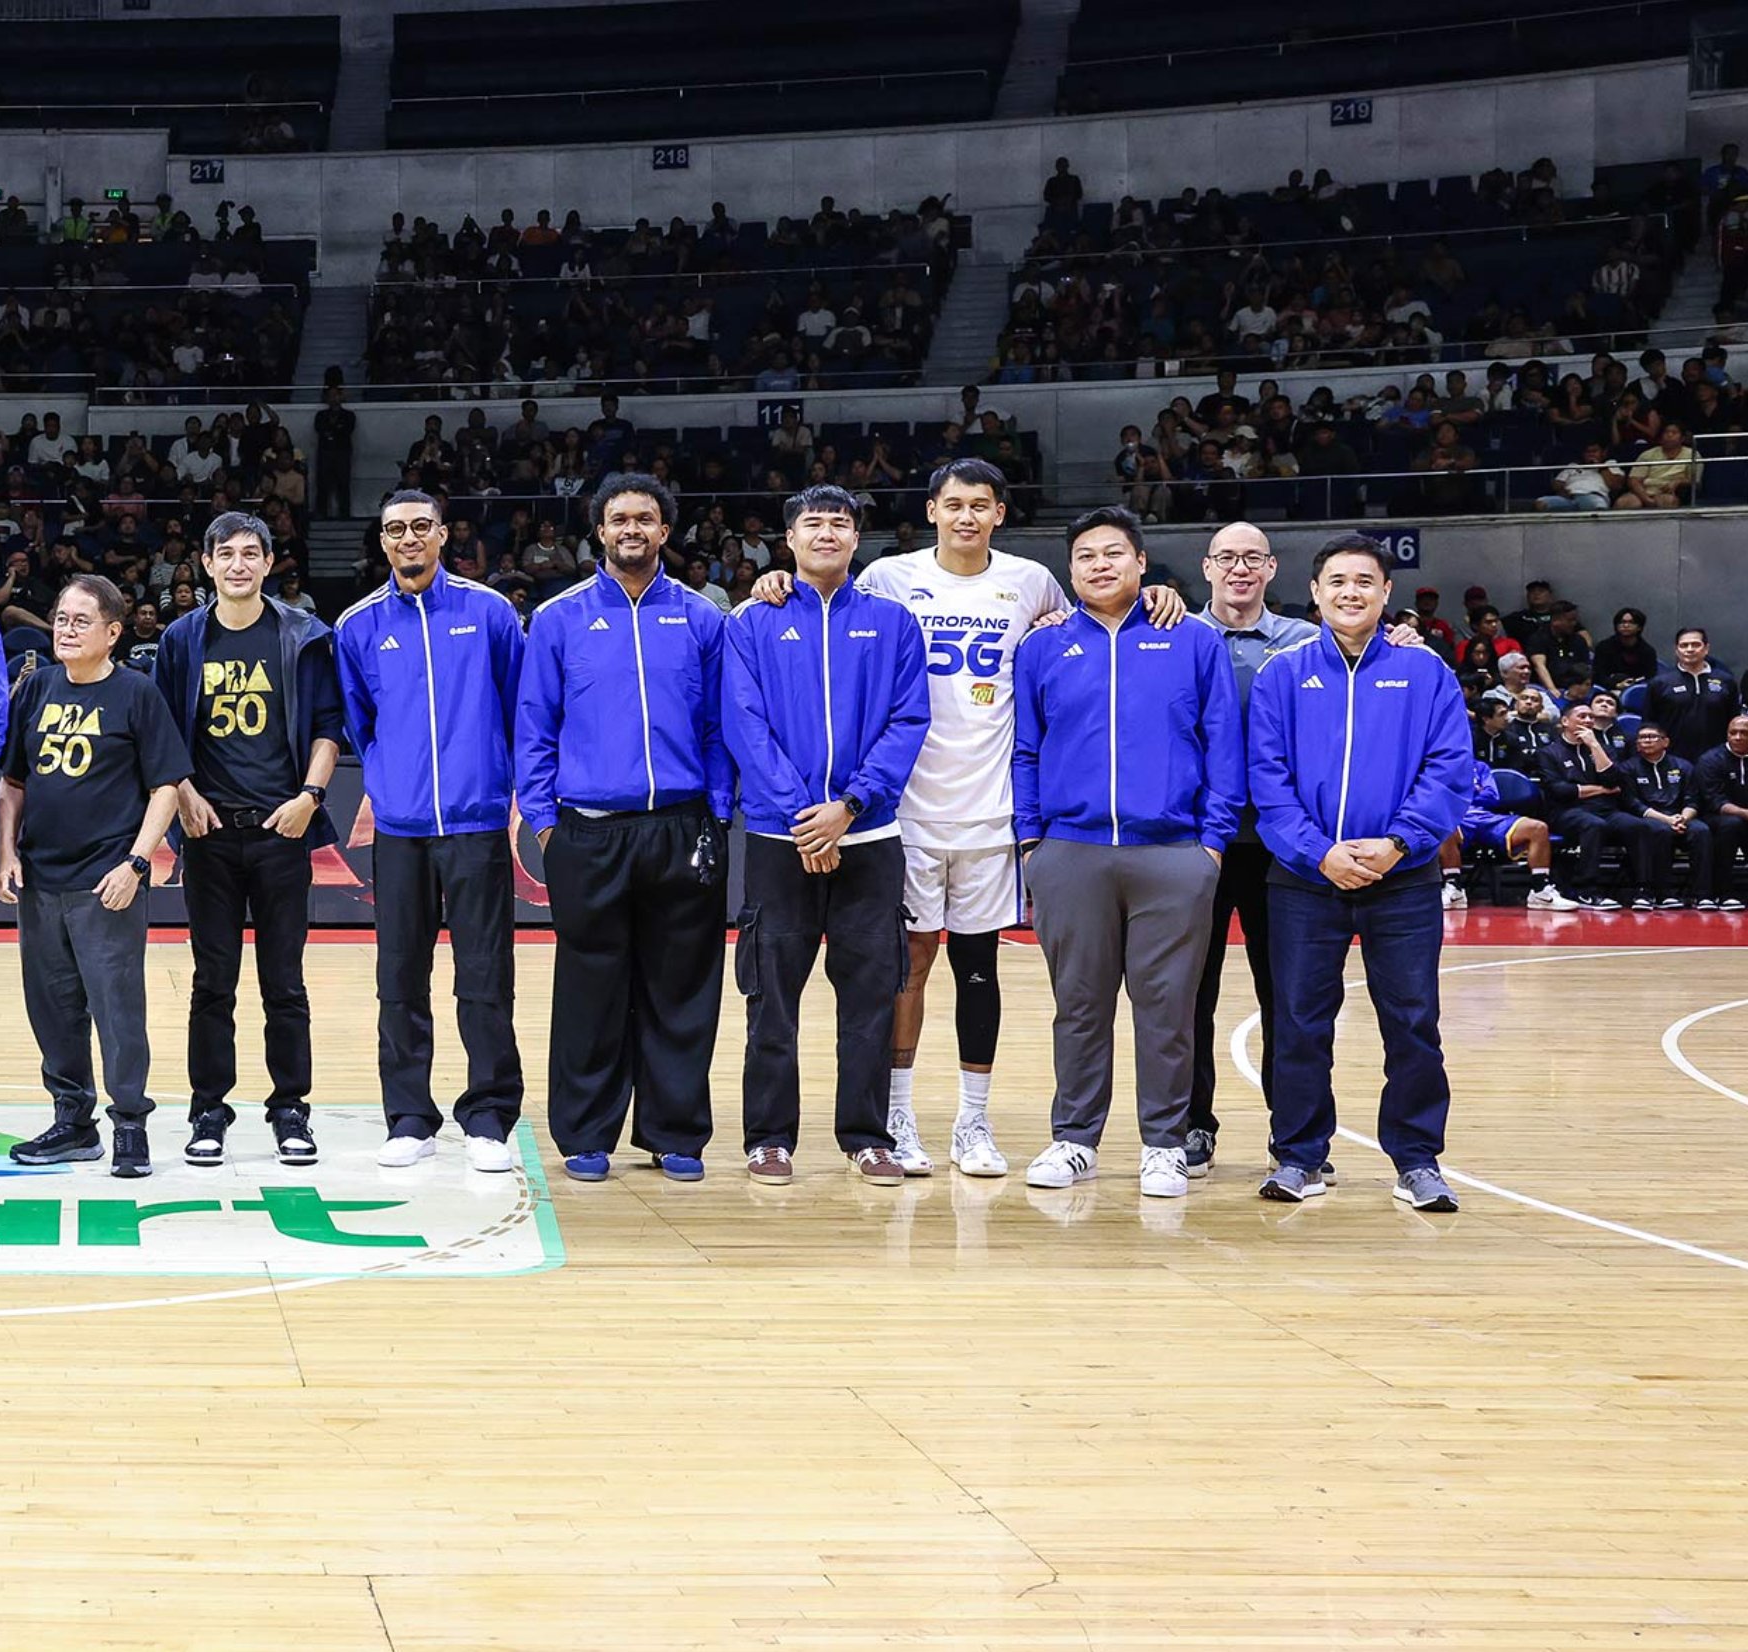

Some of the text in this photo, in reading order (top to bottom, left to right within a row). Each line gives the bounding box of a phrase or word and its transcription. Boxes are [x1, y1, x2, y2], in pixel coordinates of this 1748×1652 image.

[1333, 103, 1370, 121] 219
[191, 161, 223, 179] 217
[655, 149, 687, 165] 218
[1380, 536, 1415, 562] 16
[921, 615, 1010, 630] TROPANG
[927, 630, 1004, 678] 5G
[204, 660, 273, 696] PBA
[37, 703, 102, 736] PBA
[207, 694, 267, 738] 50
[36, 735, 93, 777] 50
